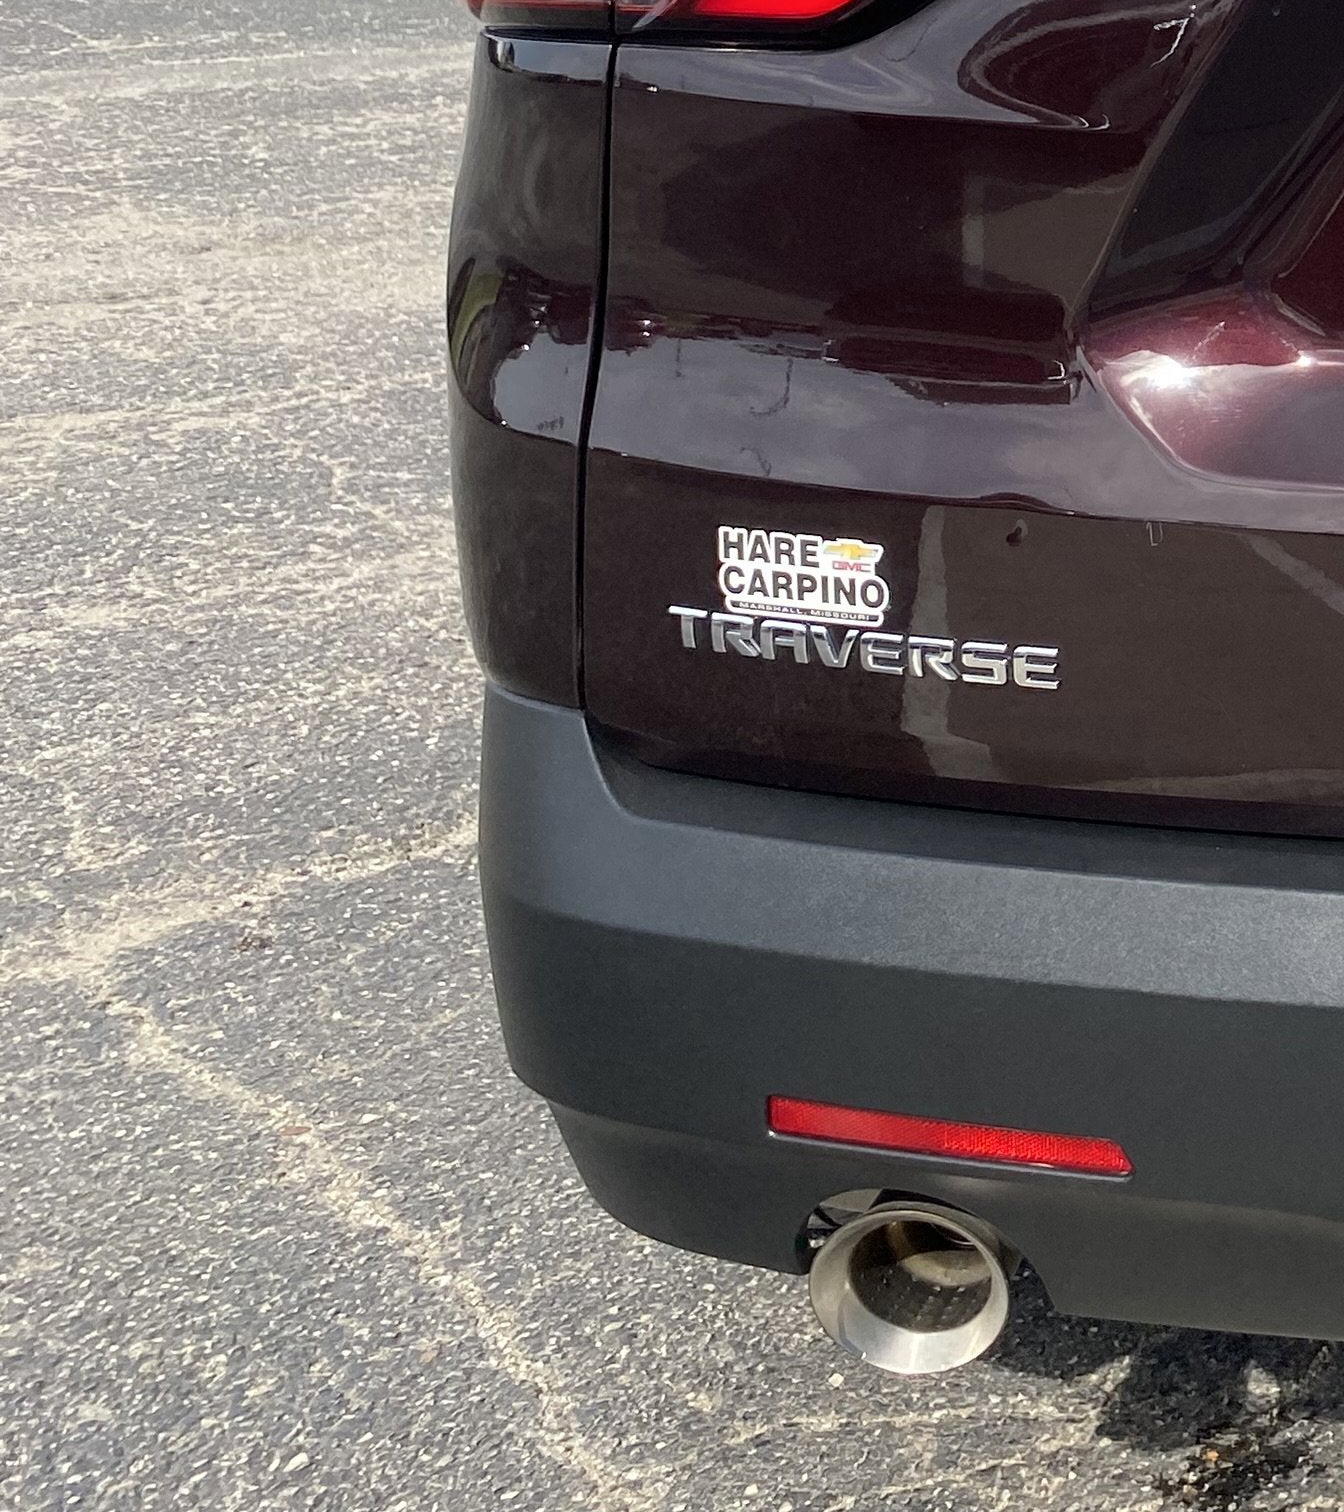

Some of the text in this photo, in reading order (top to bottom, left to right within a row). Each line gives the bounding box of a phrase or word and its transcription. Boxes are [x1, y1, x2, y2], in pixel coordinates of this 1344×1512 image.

[722, 529, 820, 568] HARE
[832, 561, 872, 573] GMC
[723, 565, 885, 609] CARPINO
[811, 609, 870, 622] MISSOURI
[668, 604, 1061, 690] TRAVERSE
